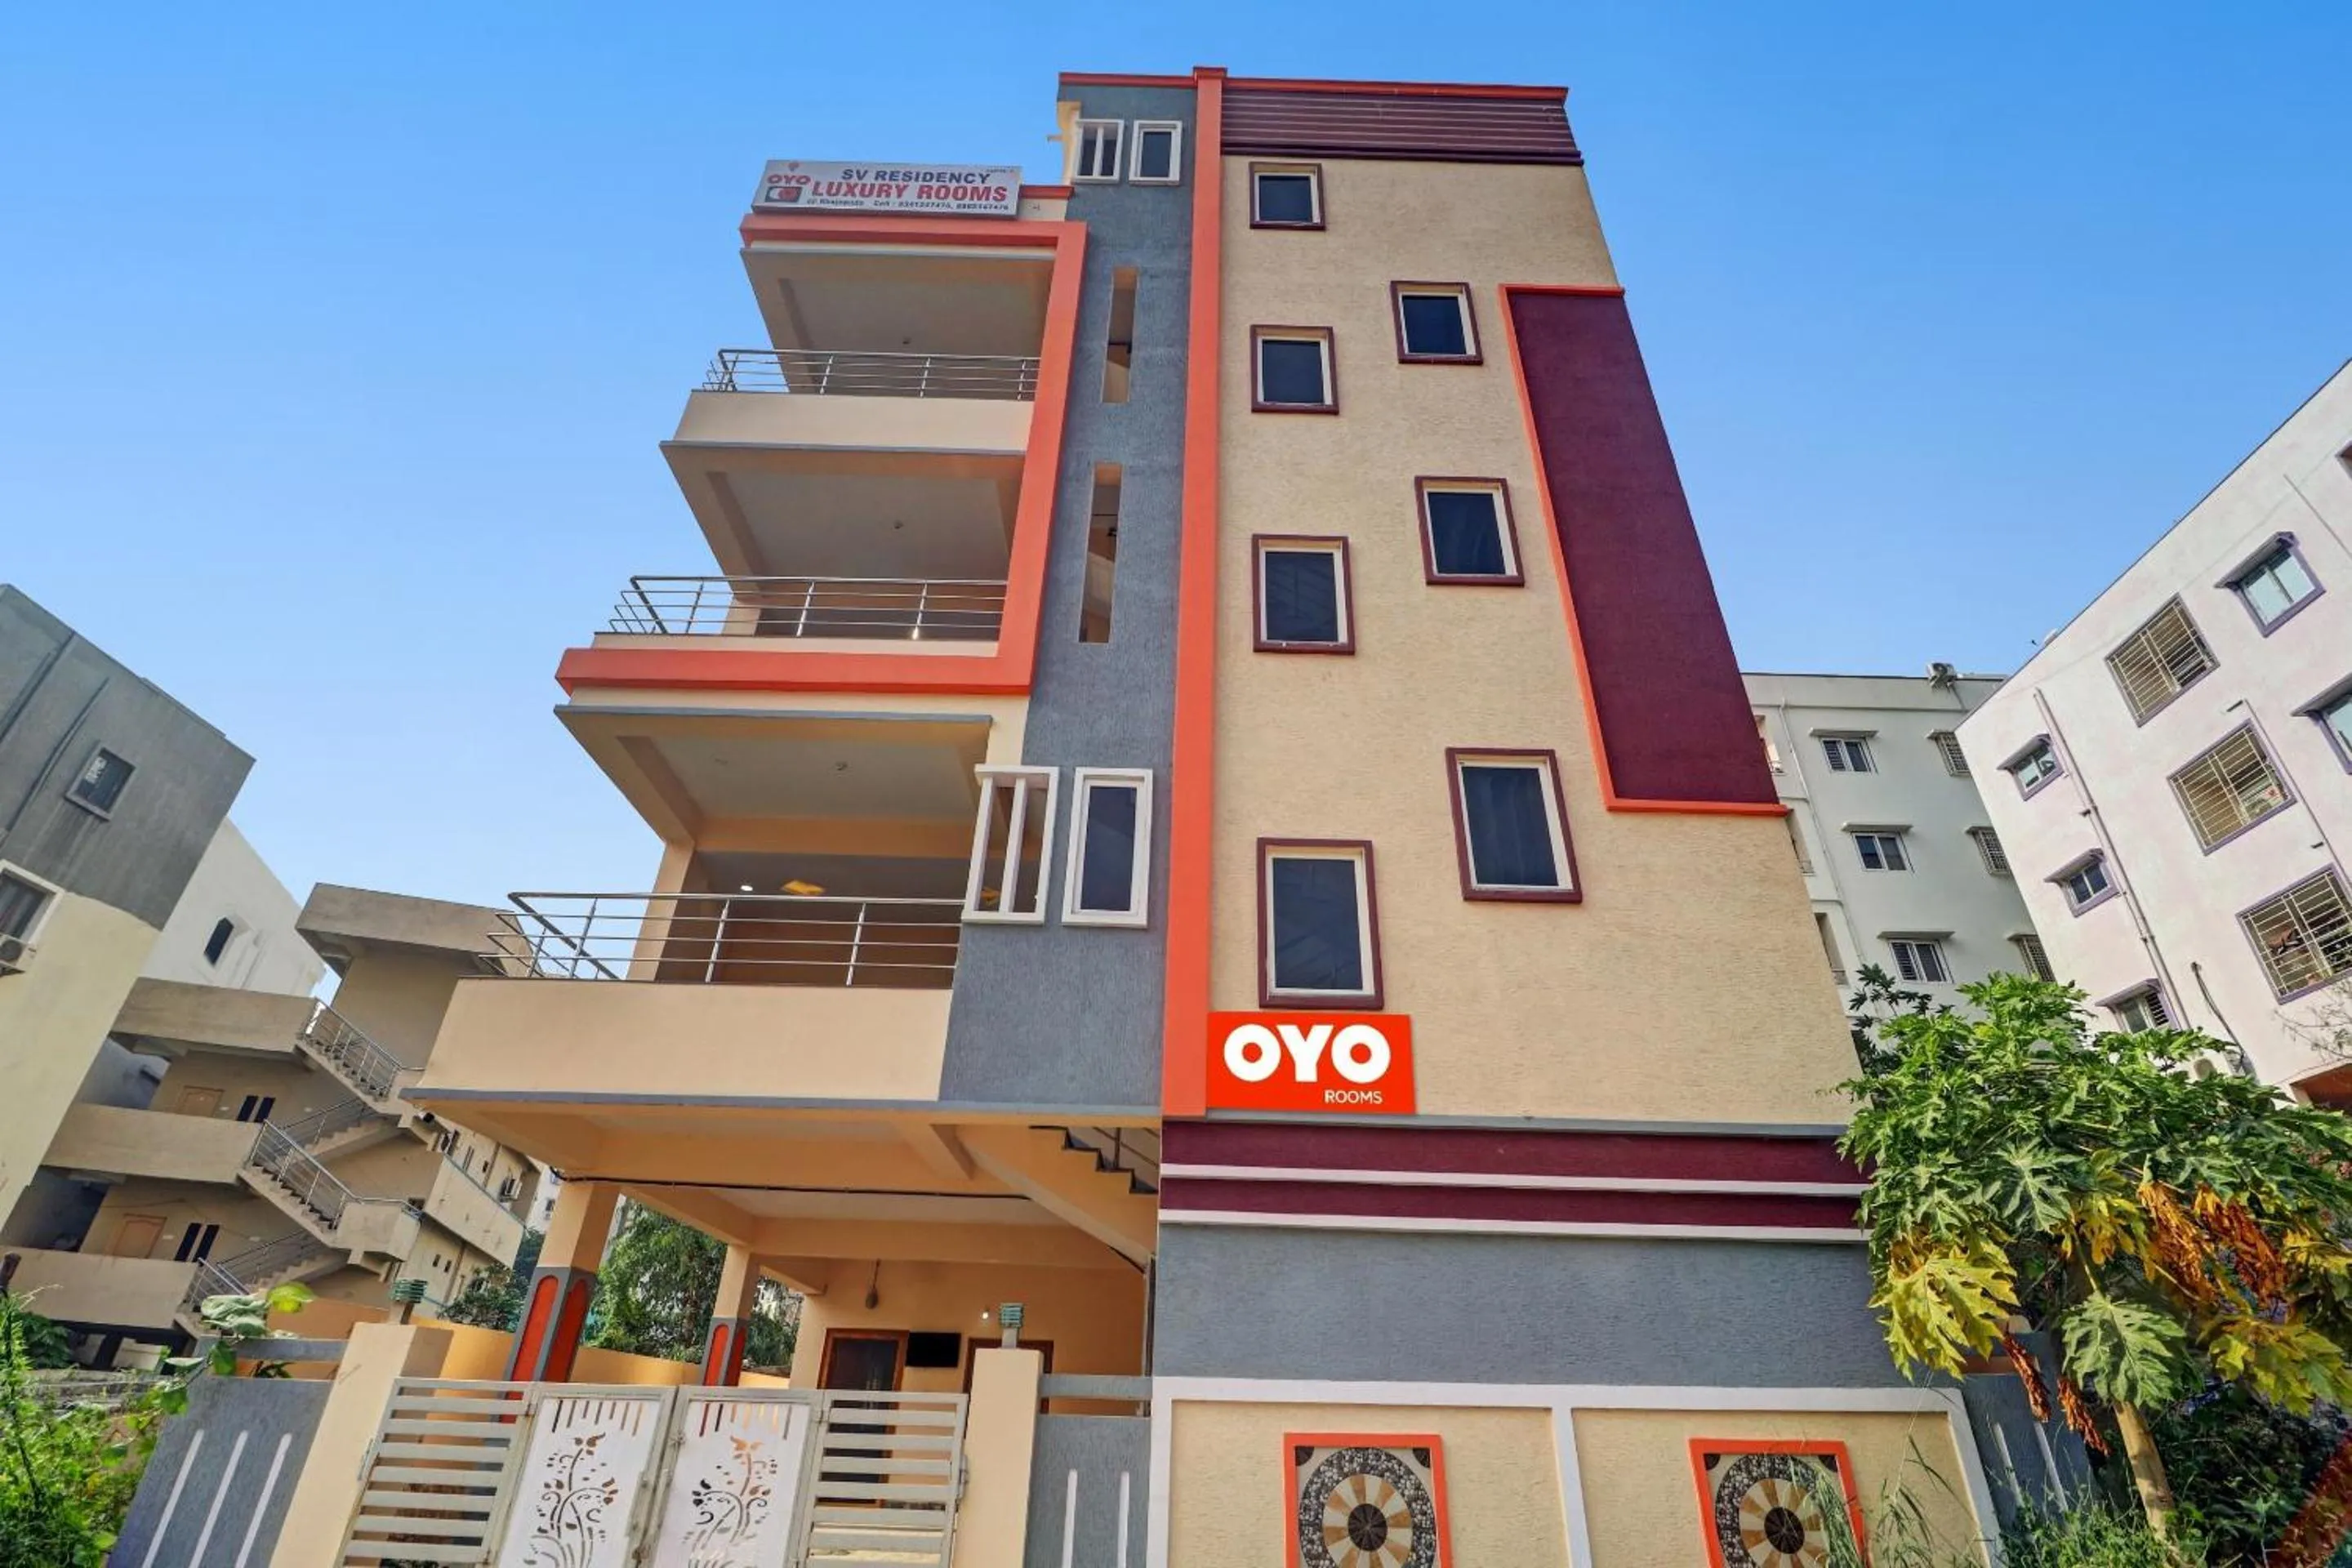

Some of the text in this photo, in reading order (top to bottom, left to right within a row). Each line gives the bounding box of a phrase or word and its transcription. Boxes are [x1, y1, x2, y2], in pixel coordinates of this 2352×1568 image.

[768, 174, 811, 185] OYO
[841, 168, 991, 184] SV RESIDENCY
[812, 180, 1008, 202] LUXURY ROOMS
[1224, 1023, 1392, 1084] OYO
[1324, 1089, 1383, 1105] ROOMS
